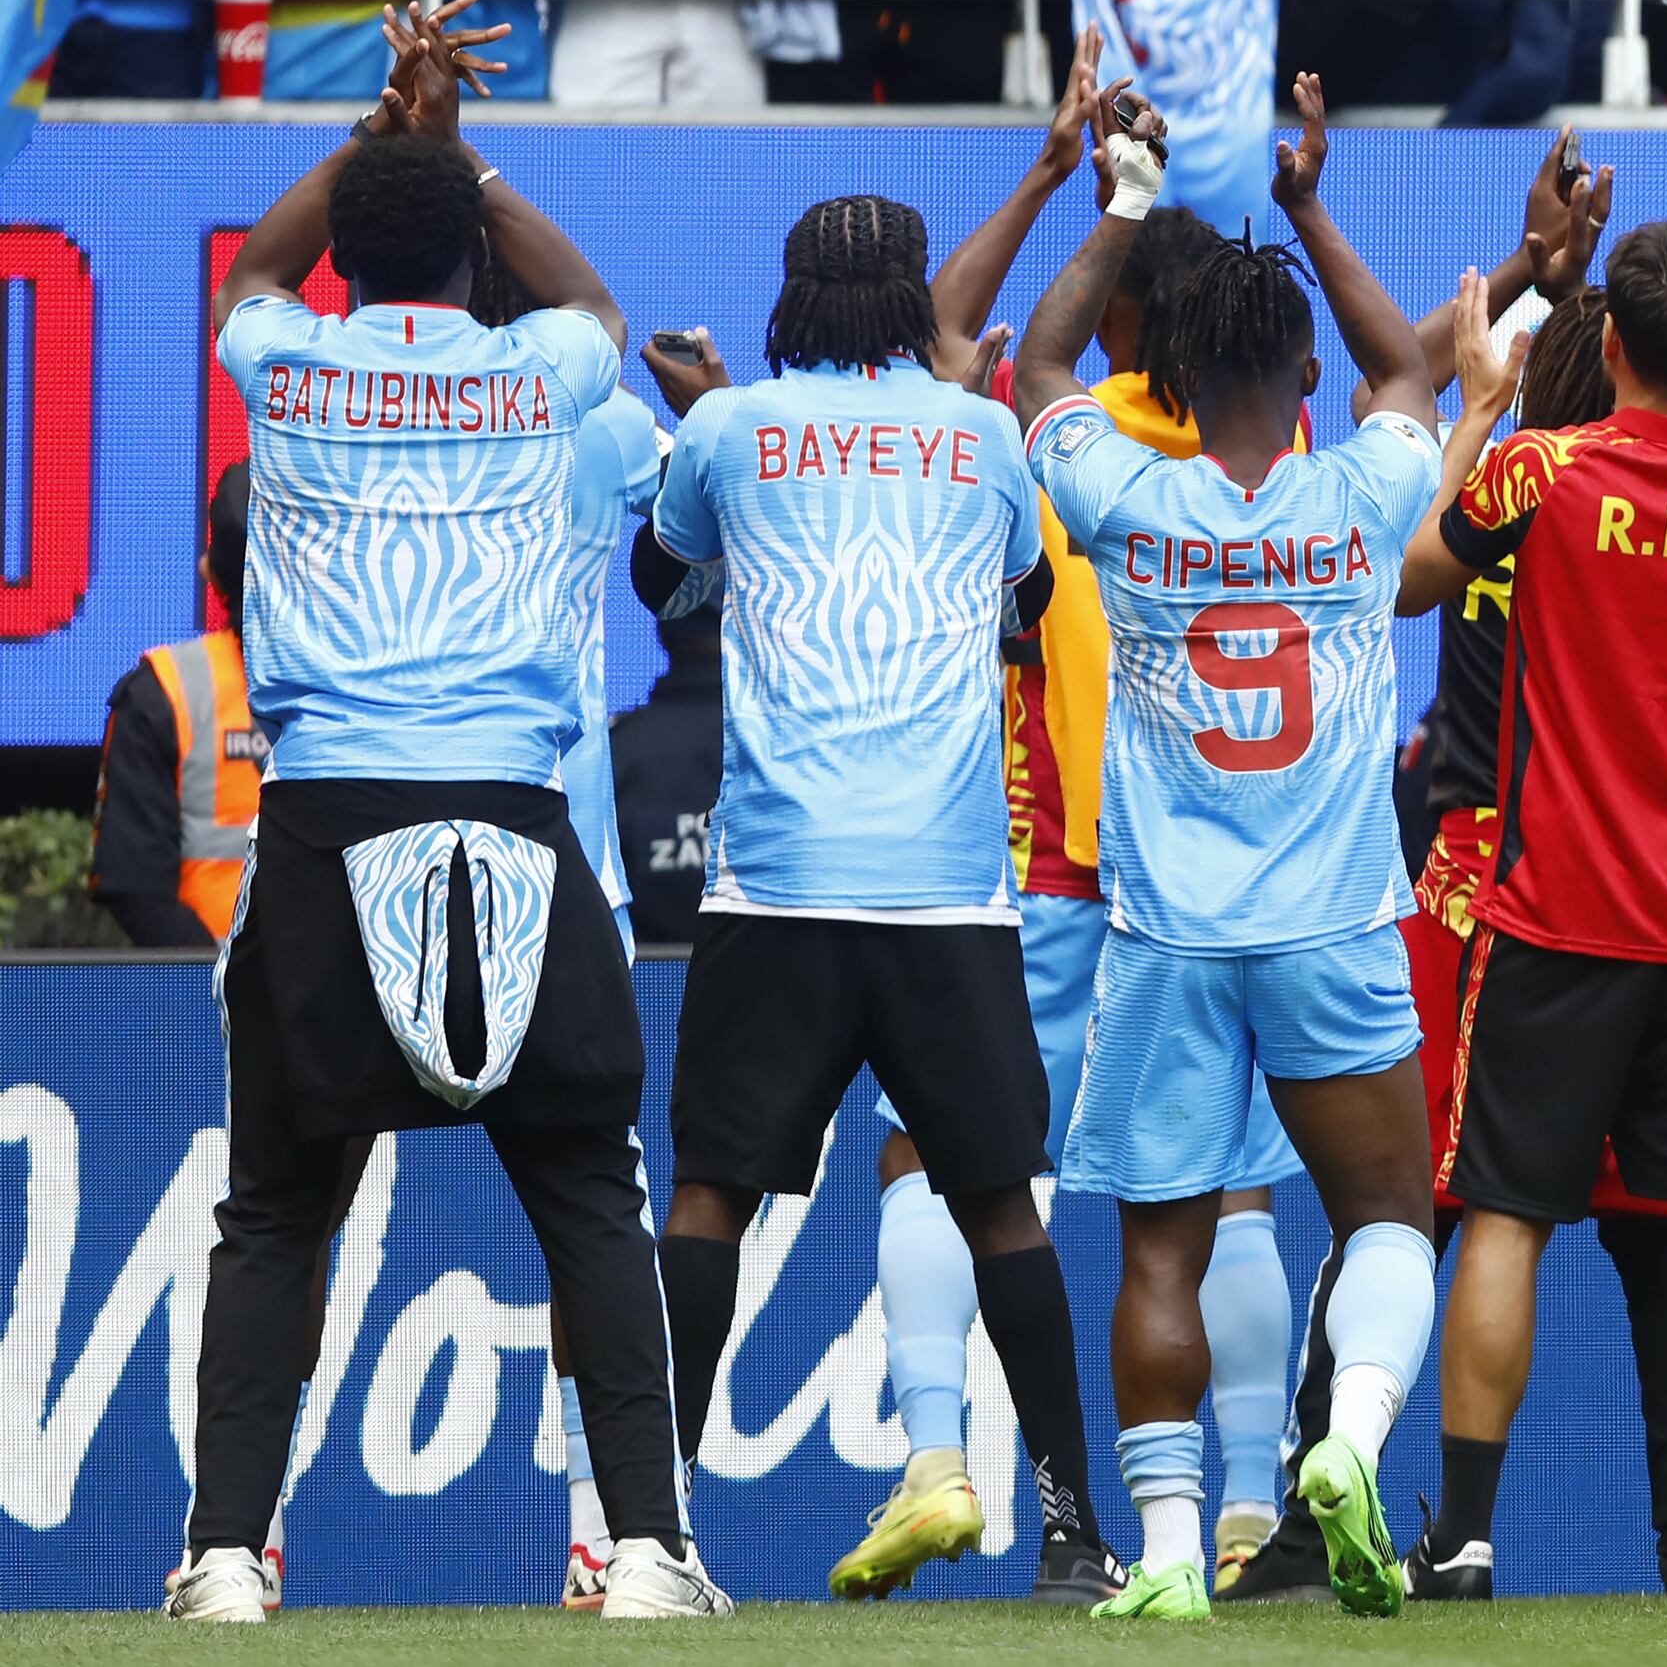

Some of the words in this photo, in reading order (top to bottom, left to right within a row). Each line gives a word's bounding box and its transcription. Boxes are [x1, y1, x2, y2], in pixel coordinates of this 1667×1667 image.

[267, 364, 551, 433] BATUBINSIKA
[755, 423, 980, 486] BAYEYE
[1125, 524, 1374, 589] CIPENGA
[1184, 601, 1315, 773] 9
[0, 1083, 1056, 1556] Wold
